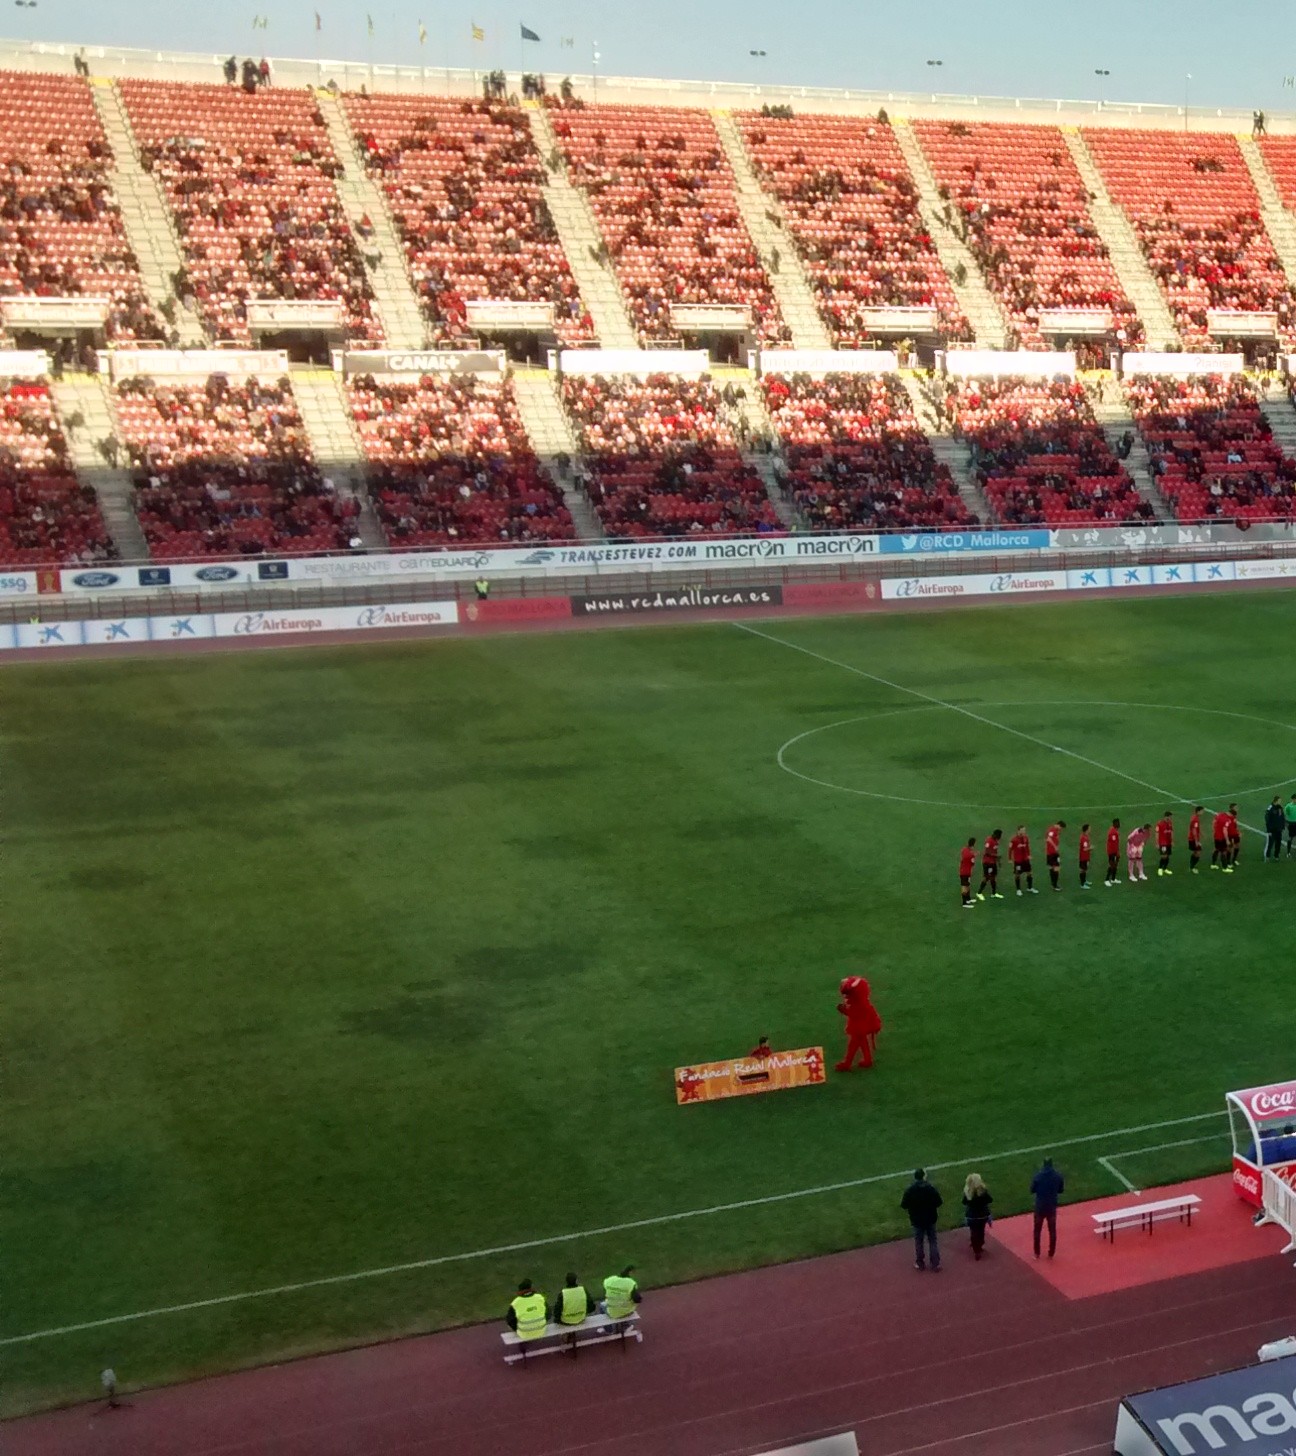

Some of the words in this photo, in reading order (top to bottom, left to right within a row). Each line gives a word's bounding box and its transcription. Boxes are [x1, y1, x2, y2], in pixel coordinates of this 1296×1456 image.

[389, 353, 460, 371] CANAL+
[705, 540, 785, 558] macron
[797, 537, 874, 554] macron
[921, 531, 1029, 550] @RCD_Mallorca
[305, 561, 390, 574] RESTAURANTE
[585, 590, 770, 611] www.rcdmallorca.es
[768, 1055, 816, 1070] Mallorca
